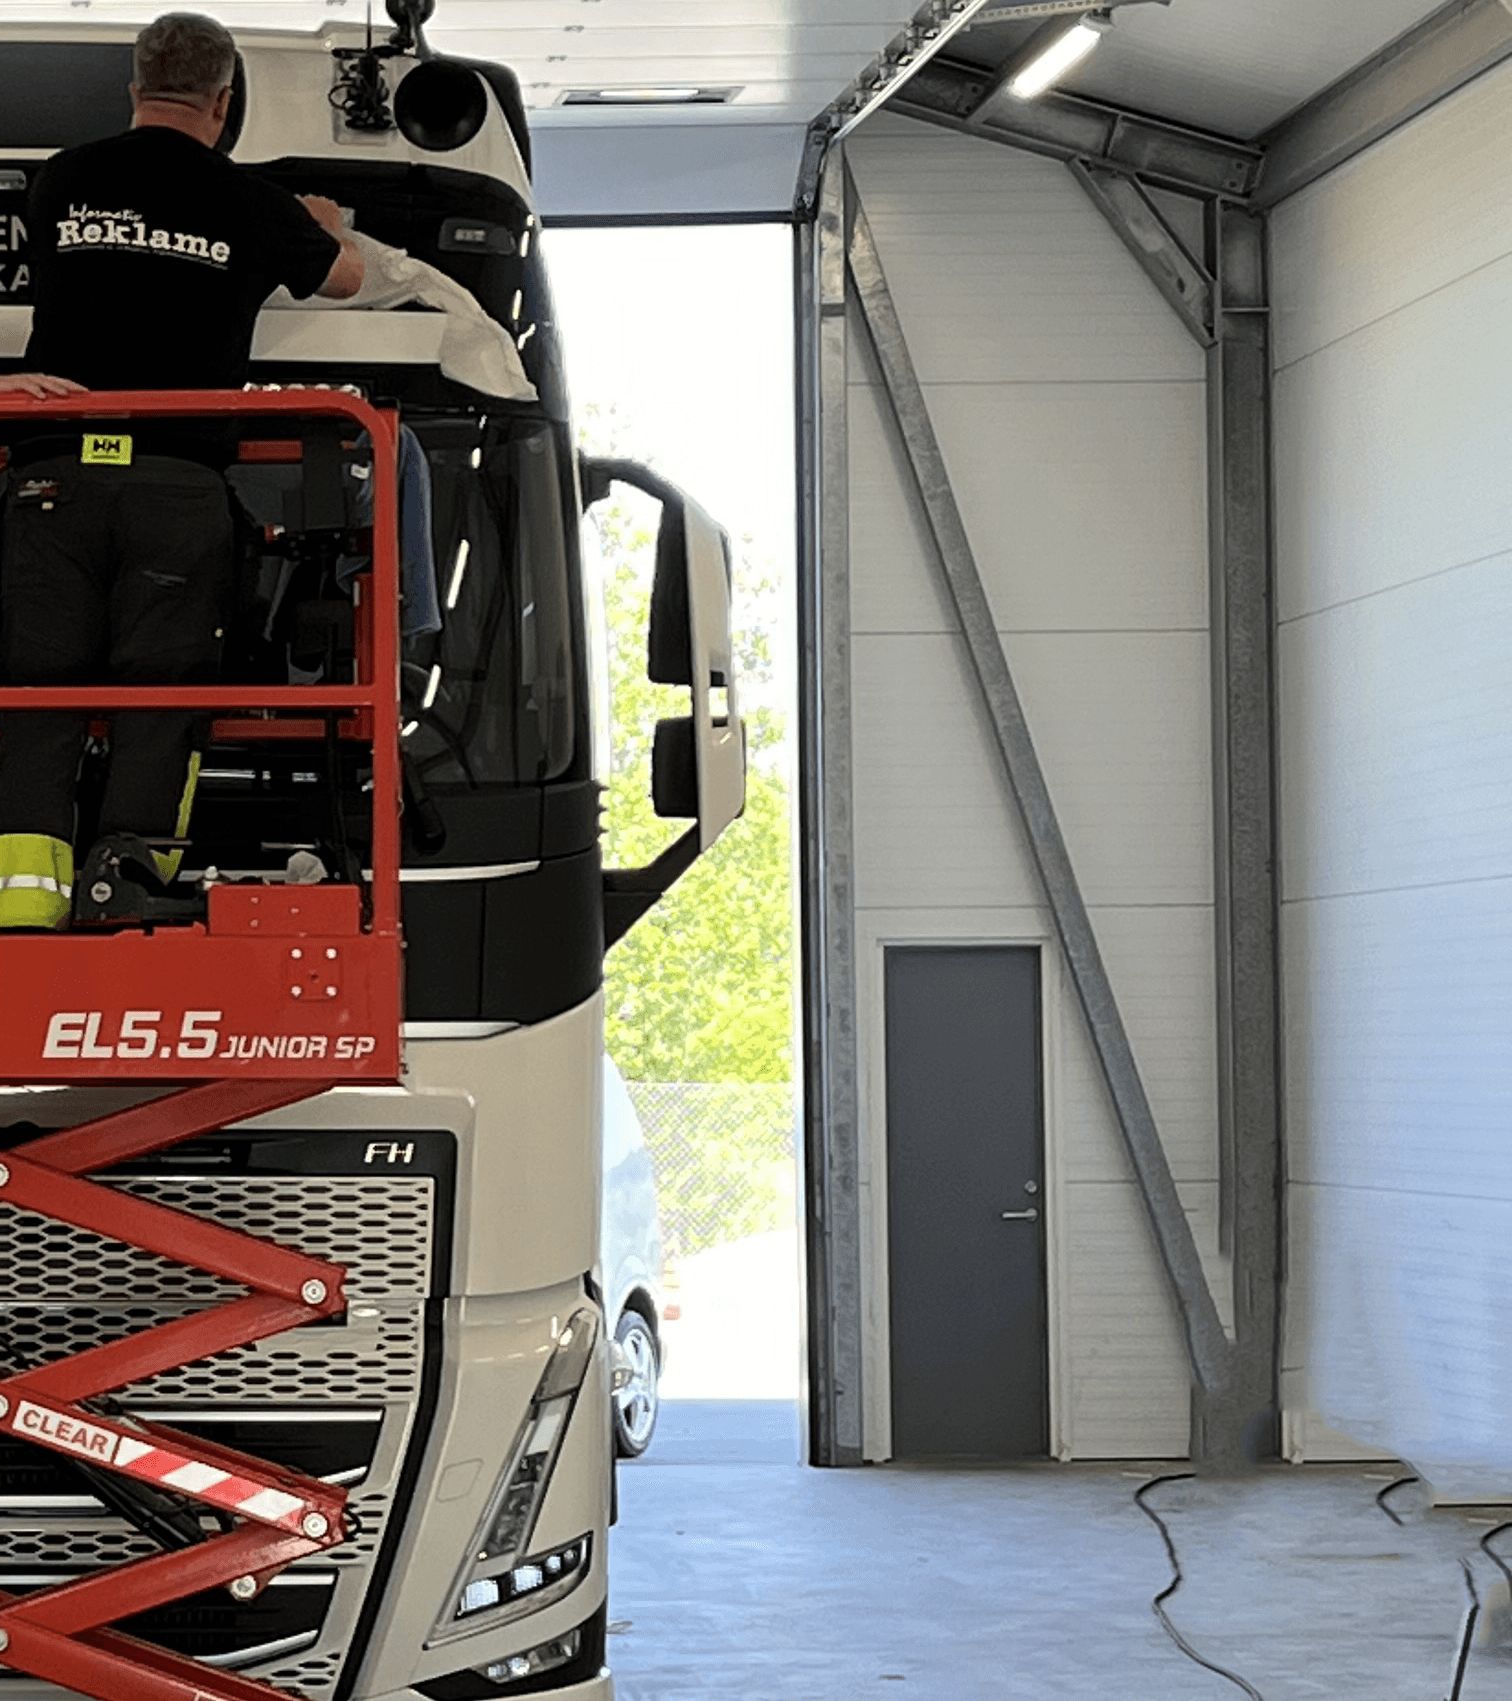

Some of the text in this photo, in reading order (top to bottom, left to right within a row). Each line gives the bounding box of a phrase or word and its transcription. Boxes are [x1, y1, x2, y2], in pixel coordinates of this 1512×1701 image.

[56, 220, 231, 263] Reklame
[42, 1010, 375, 1059] EL5.5 JUNIOR SP
[364, 1142, 415, 1163] FH
[22, 1409, 109, 1455] CLEAR
